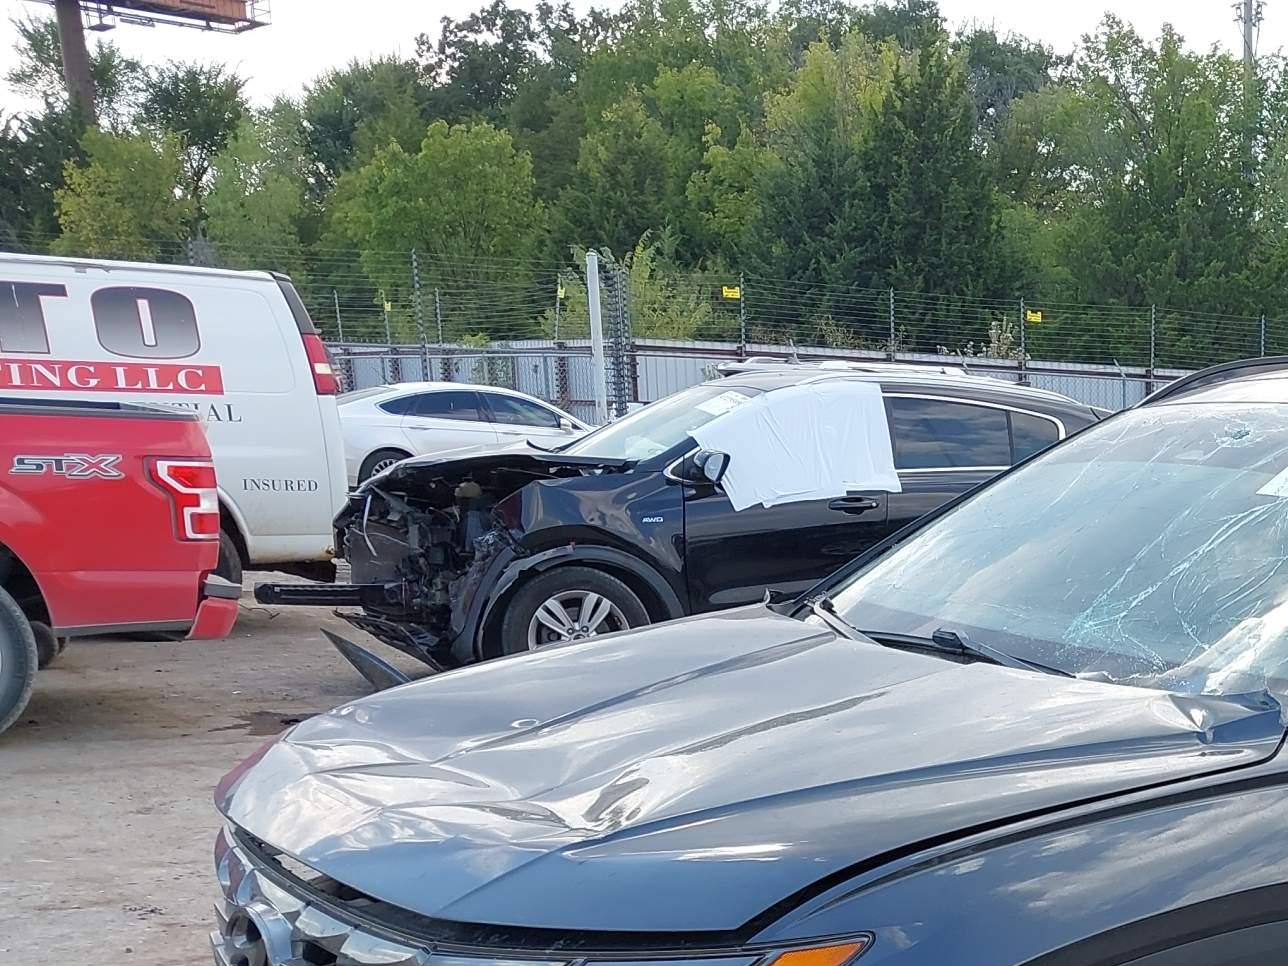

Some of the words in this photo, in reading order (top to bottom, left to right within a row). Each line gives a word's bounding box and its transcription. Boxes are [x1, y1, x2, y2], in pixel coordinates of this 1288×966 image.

[0, 362, 101, 389] ING
[111, 366, 206, 392] LLC
[8, 453, 126, 480] STX
[242, 478, 319, 492] INSURED
